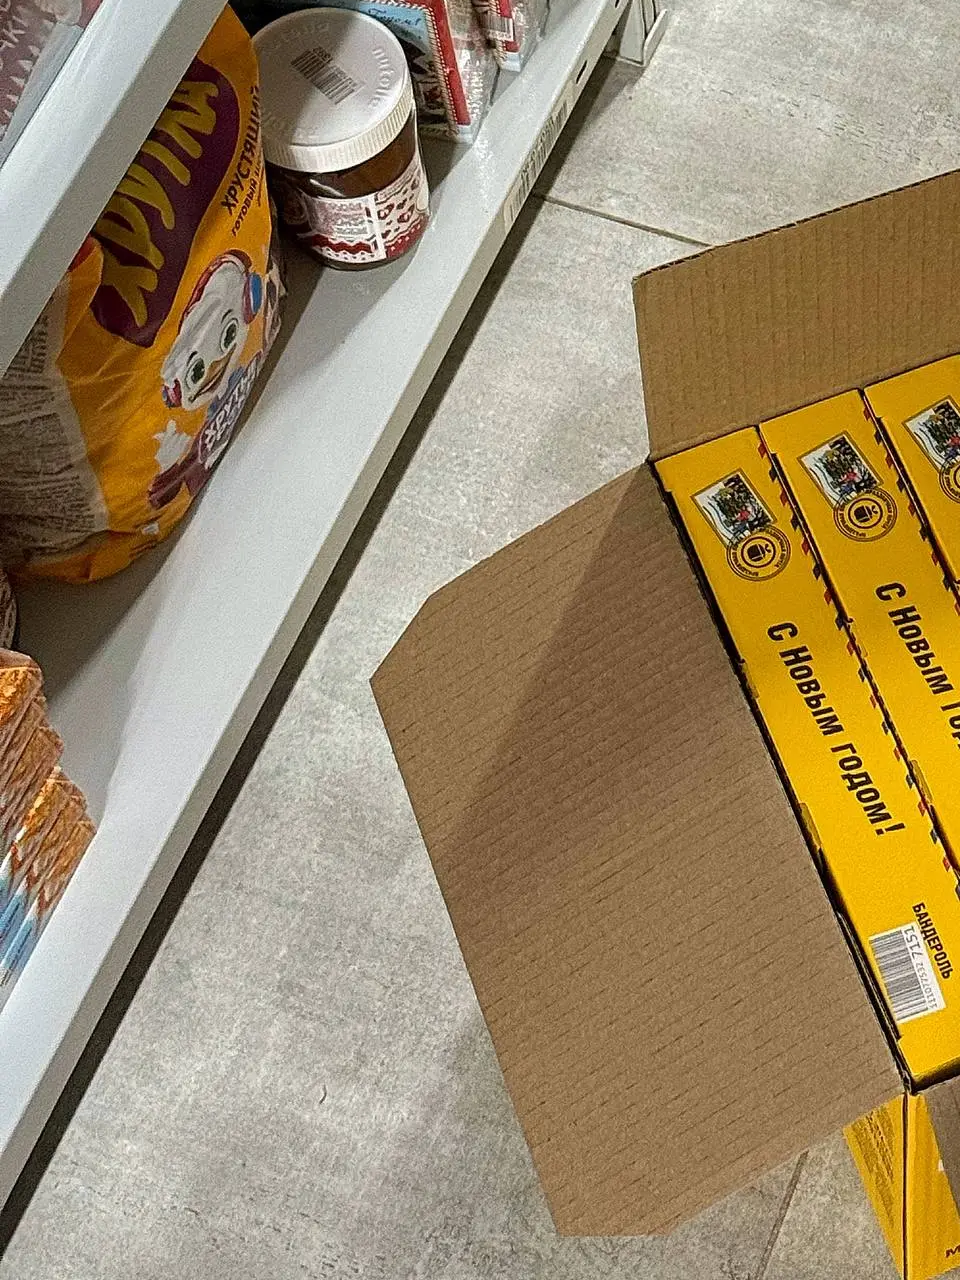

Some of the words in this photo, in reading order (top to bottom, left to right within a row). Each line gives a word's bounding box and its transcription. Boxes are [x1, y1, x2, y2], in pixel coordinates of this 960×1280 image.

[221, 85, 261, 216] ХРУСТЯЩИЙ
[876, 583, 906, 602] С
[768, 623, 798, 642] С
[888, 606, 954, 695] Новым
[780, 646, 843, 736] Новым
[902, 926, 923, 958] 7151
[912, 901, 951, 980] БАНДЕРОЛЬ
